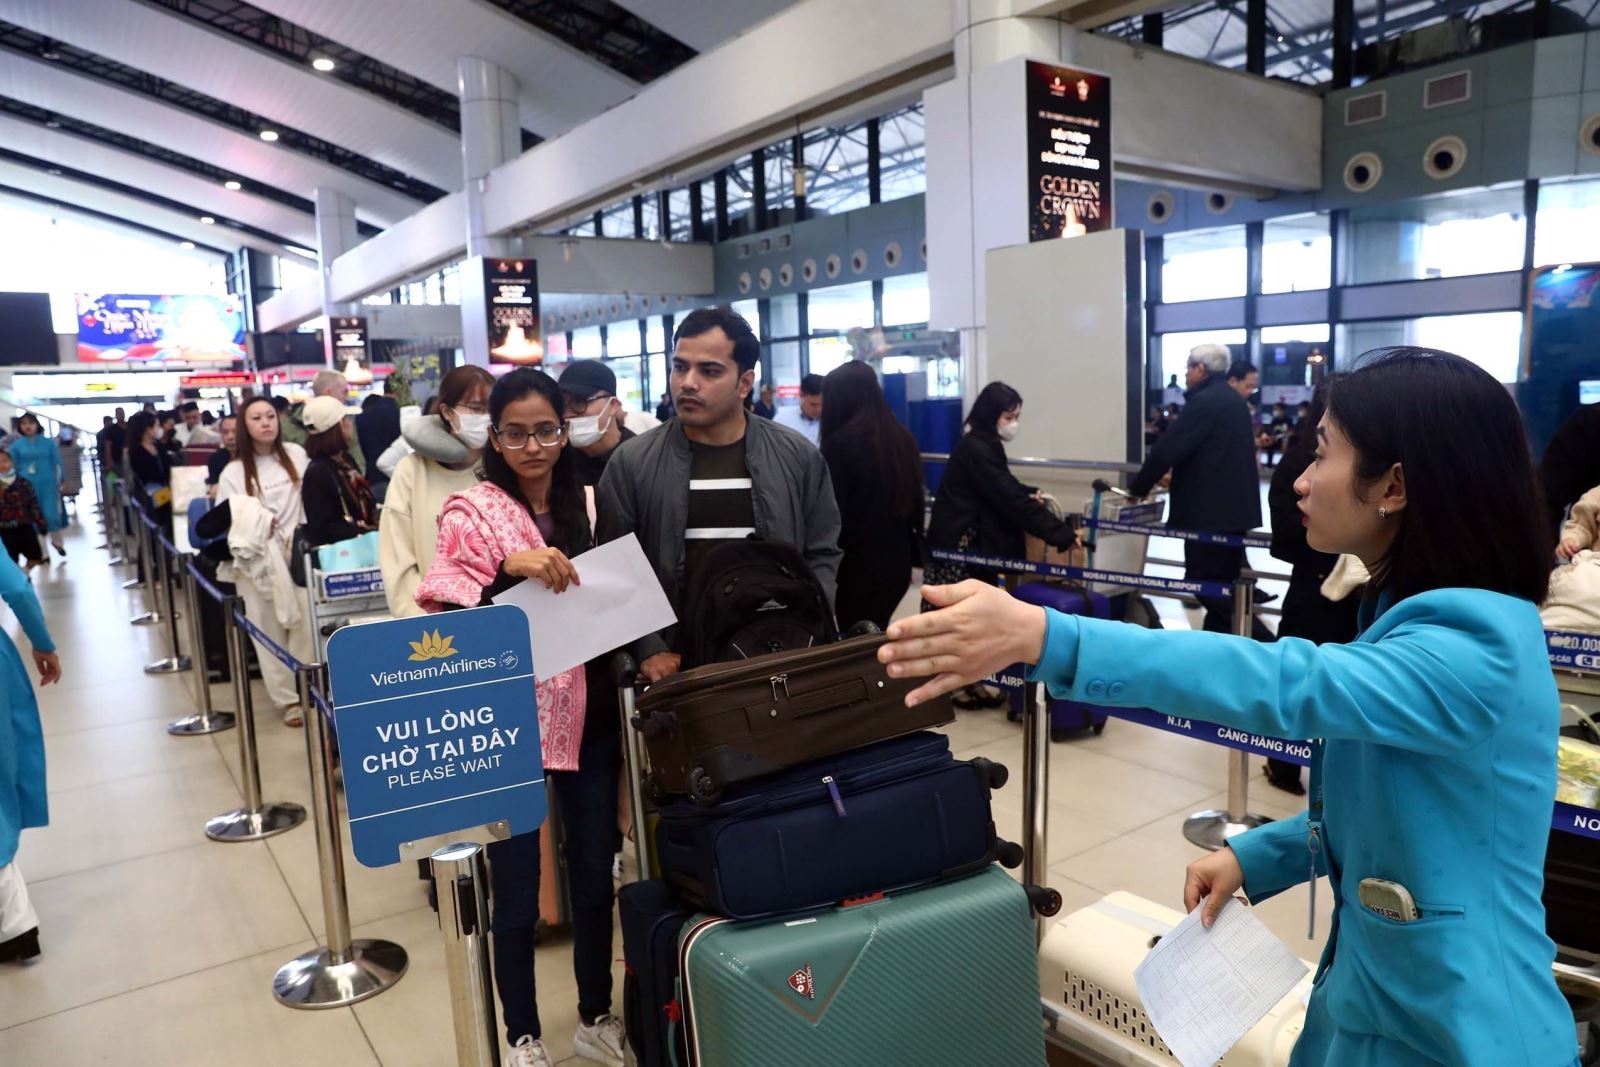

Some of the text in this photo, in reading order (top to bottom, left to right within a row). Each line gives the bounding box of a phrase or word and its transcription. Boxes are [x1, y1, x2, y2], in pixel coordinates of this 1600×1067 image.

[1040, 174, 1100, 200] GOLDEN
[1050, 566, 1067, 576] N.I.A
[1108, 574, 1166, 588] INTERNATIONAL
[1168, 580, 1202, 592] AIRPORT
[370, 666, 438, 687] Vietnam
[439, 656, 497, 677] Airlines
[1000, 674, 1024, 688] AIRP
[376, 706, 494, 743] VUI LÒNG
[1167, 716, 1192, 730] N.I.A
[1251, 734, 1283, 752] HÀNG
[362, 727, 520, 774] CHỜ TẠI ĐÂY
[388, 754, 503, 790] PLEASE WAIT
[1574, 814, 1600, 831] NO
